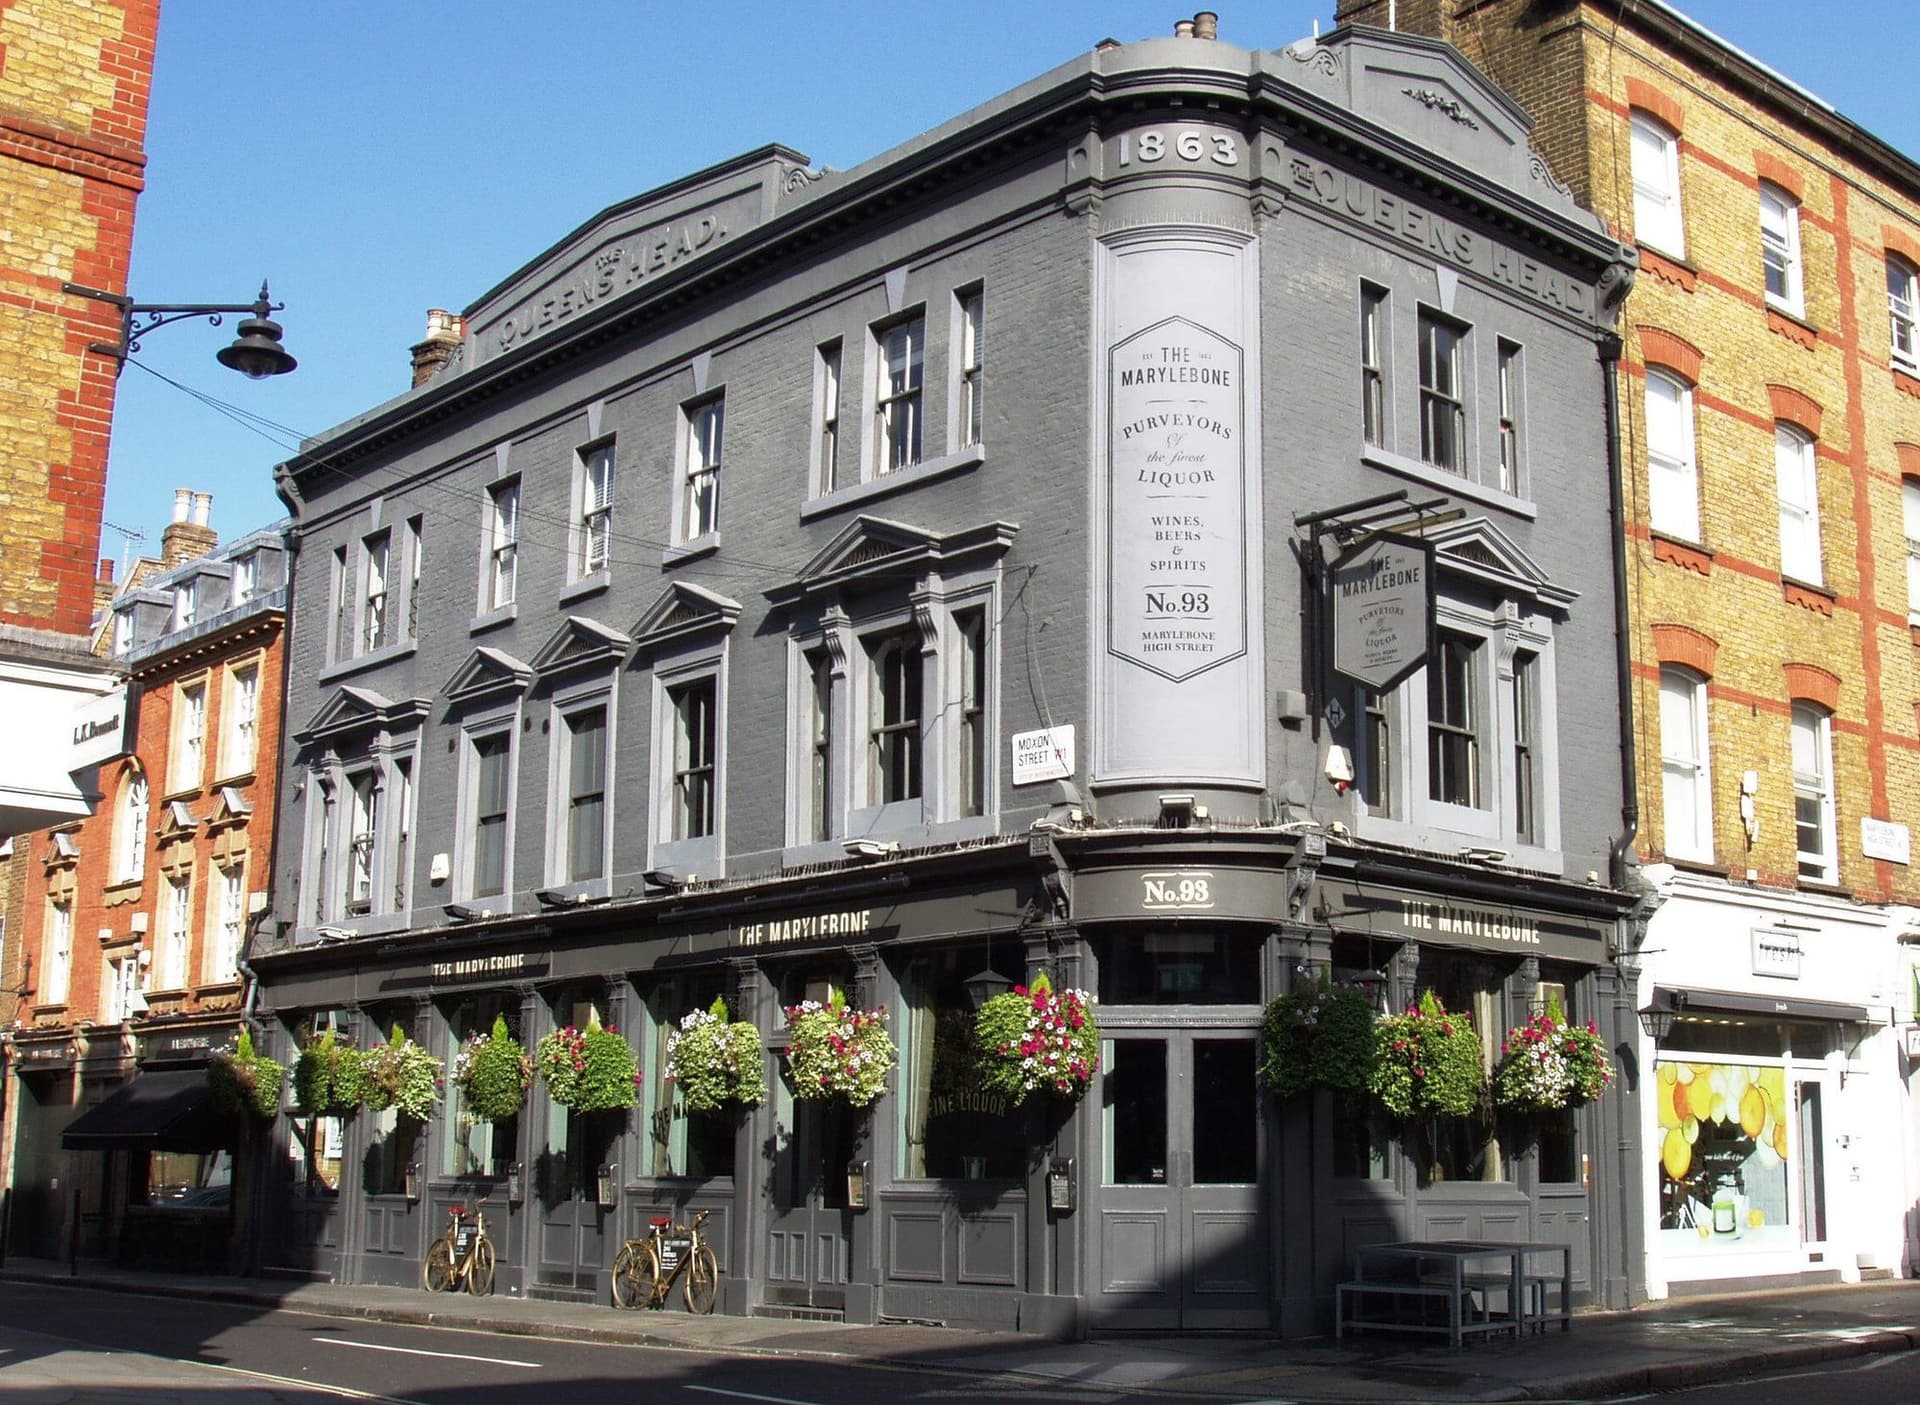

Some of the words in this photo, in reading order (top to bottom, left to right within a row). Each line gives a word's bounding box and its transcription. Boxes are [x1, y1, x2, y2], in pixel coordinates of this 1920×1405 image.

[1119, 131, 1239, 167] 1863
[1313, 168, 1473, 264] QUEENS
[500, 267, 615, 352] QUEENS
[1161, 347, 1190, 363] THE
[1121, 367, 1231, 387] MARYLEBONE
[1122, 413, 1233, 440] PURVEYORS
[1146, 451, 1166, 463] the
[1165, 450, 1206, 466] finest
[1138, 469, 1216, 488] LIQUOR
[1155, 531, 1202, 542] BEERS
[1172, 545, 1184, 556] &
[1150, 560, 1207, 572] SPIRITS
[1370, 555, 1392, 573] THE
[1342, 568, 1420, 598] MARYLEBONE
[1145, 592, 1210, 614] No.93
[1142, 630, 1216, 641] MARYLEBONE
[1143, 643, 1172, 653] HIGH
[1175, 642, 1216, 653] STREET
[1018, 735, 1049, 751] MOXON
[1018, 750, 1049, 767] STREET
[1144, 879, 1210, 903] No.93
[740, 924, 764, 947] THE
[769, 910, 871, 943] MARYLEBONE
[1401, 899, 1432, 930] THE
[1438, 904, 1541, 945] MARYLEBONE
[432, 963, 453, 978] THE
[455, 953, 525, 976] MARYLEBONE
[959, 1091, 1007, 1119] LIQUOR
